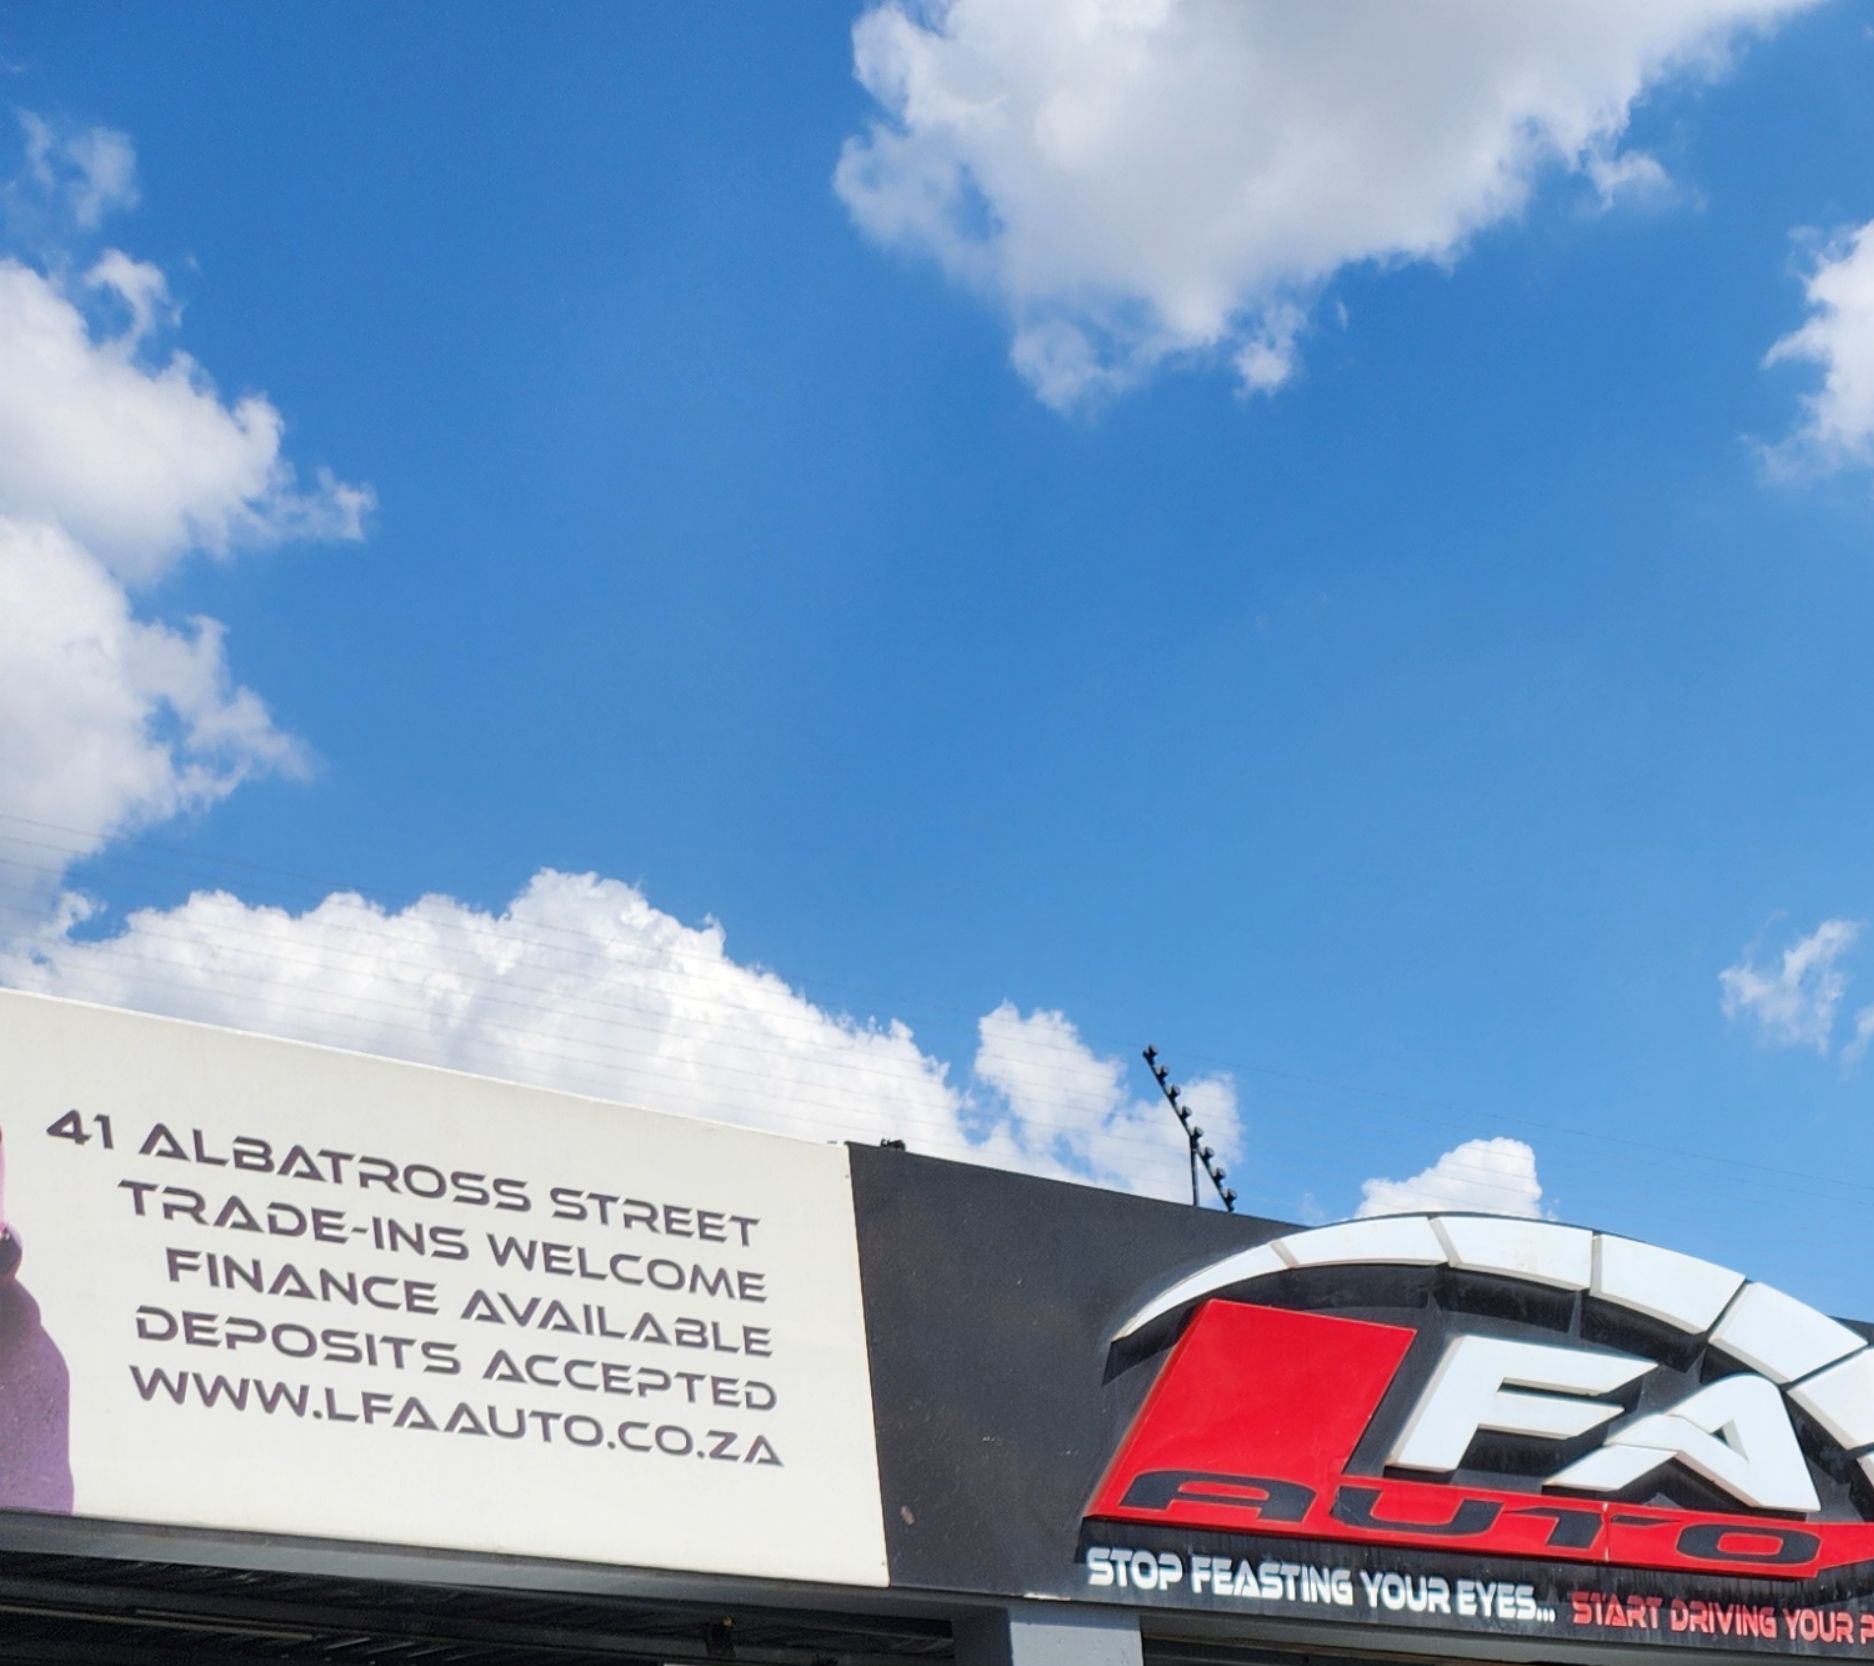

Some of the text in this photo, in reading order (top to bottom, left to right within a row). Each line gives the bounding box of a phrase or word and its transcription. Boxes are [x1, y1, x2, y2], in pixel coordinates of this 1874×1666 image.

[46, 1109, 761, 1247] 41 ALBATROSS STREET
[117, 1179, 768, 1304] TRADE-INS WELCOME
[166, 1247, 774, 1358] FINANCE AVAILABLE
[135, 1305, 778, 1412] DEPOSITS ACCEPTED
[129, 1364, 785, 1467] WWW.LFAAUTO.CO.ZA
[1119, 1470, 1822, 1567] AUTO
[1087, 1546, 1183, 1594] STOP
[1191, 1555, 1353, 1607] FEASTING
[1360, 1570, 1451, 1615] YOUR
[1456, 1579, 1556, 1623] EYES...
[1570, 1591, 1663, 1631] START
[1669, 1599, 1778, 1640] DRIVING
[1783, 1608, 1855, 1647] YOUR
